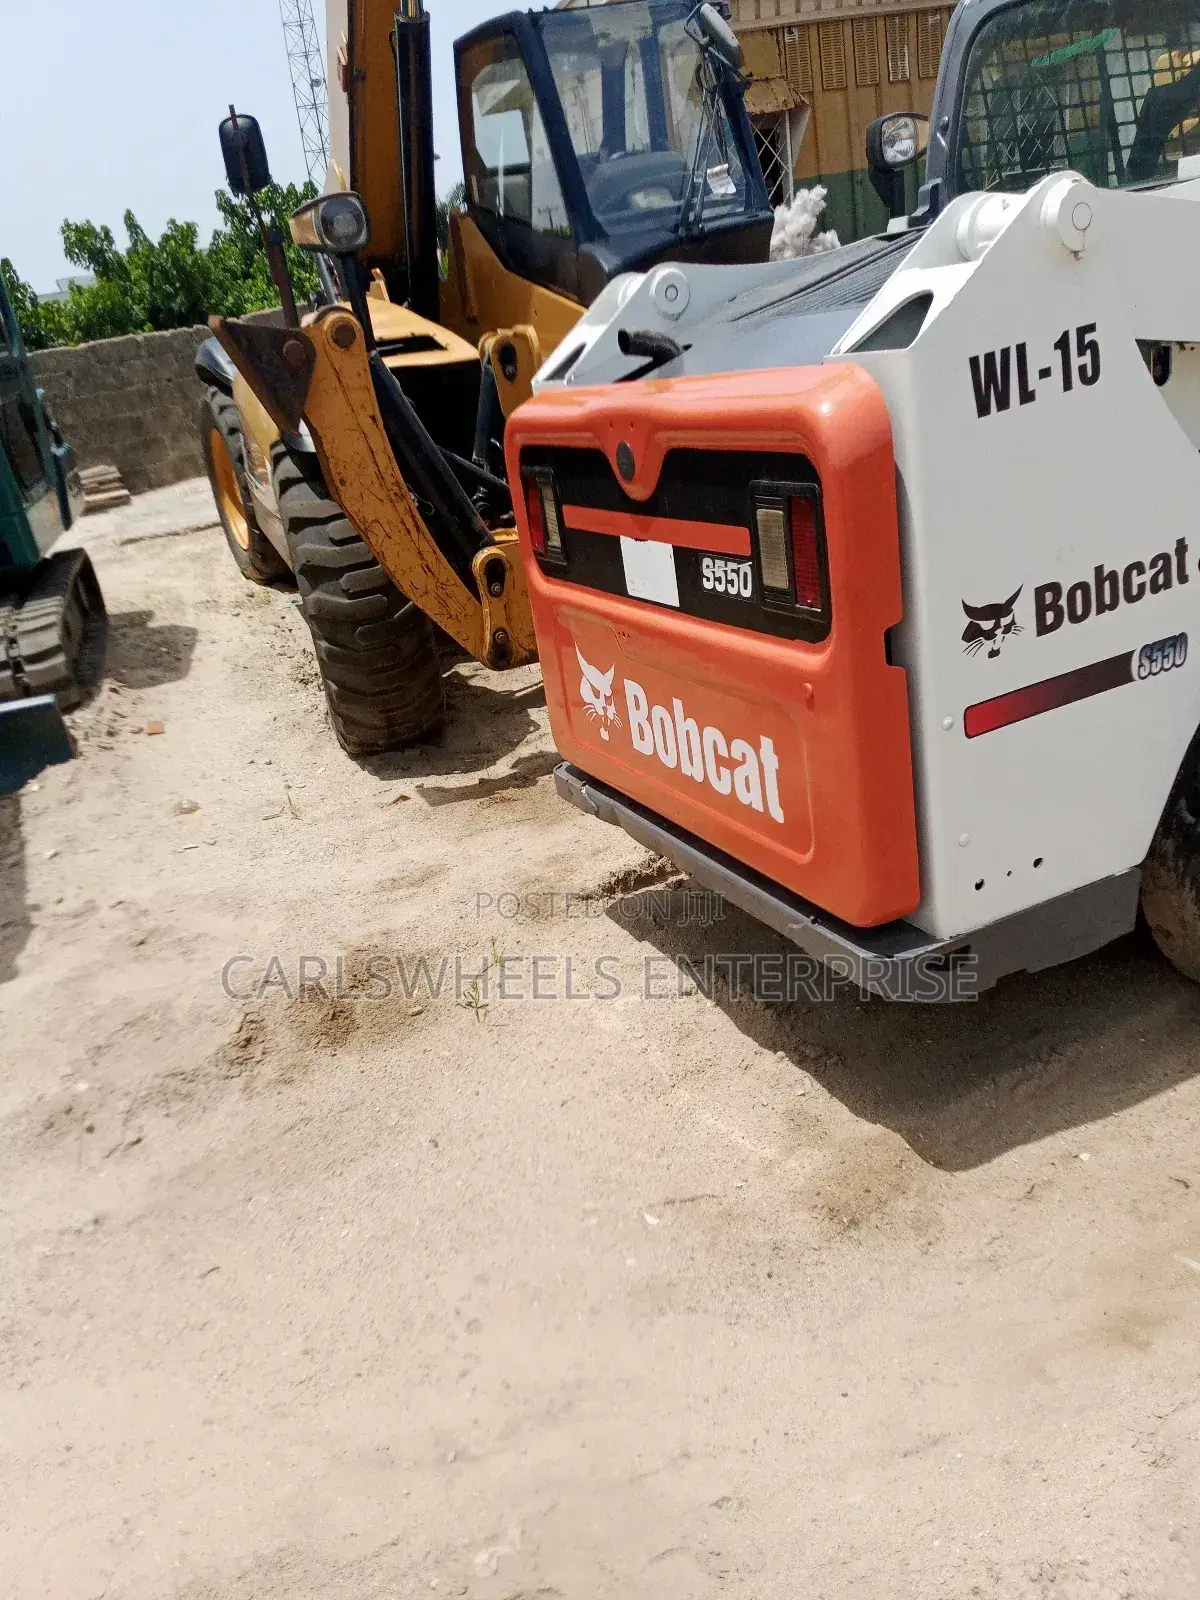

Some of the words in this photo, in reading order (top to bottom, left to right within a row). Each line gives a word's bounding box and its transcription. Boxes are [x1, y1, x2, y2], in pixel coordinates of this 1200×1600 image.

[968, 322, 1100, 419] WL-15
[702, 557, 753, 598] S550
[1034, 536, 1190, 637] Bobcat
[1138, 631, 1188, 680] S550
[623, 678, 785, 824] Bobcat
